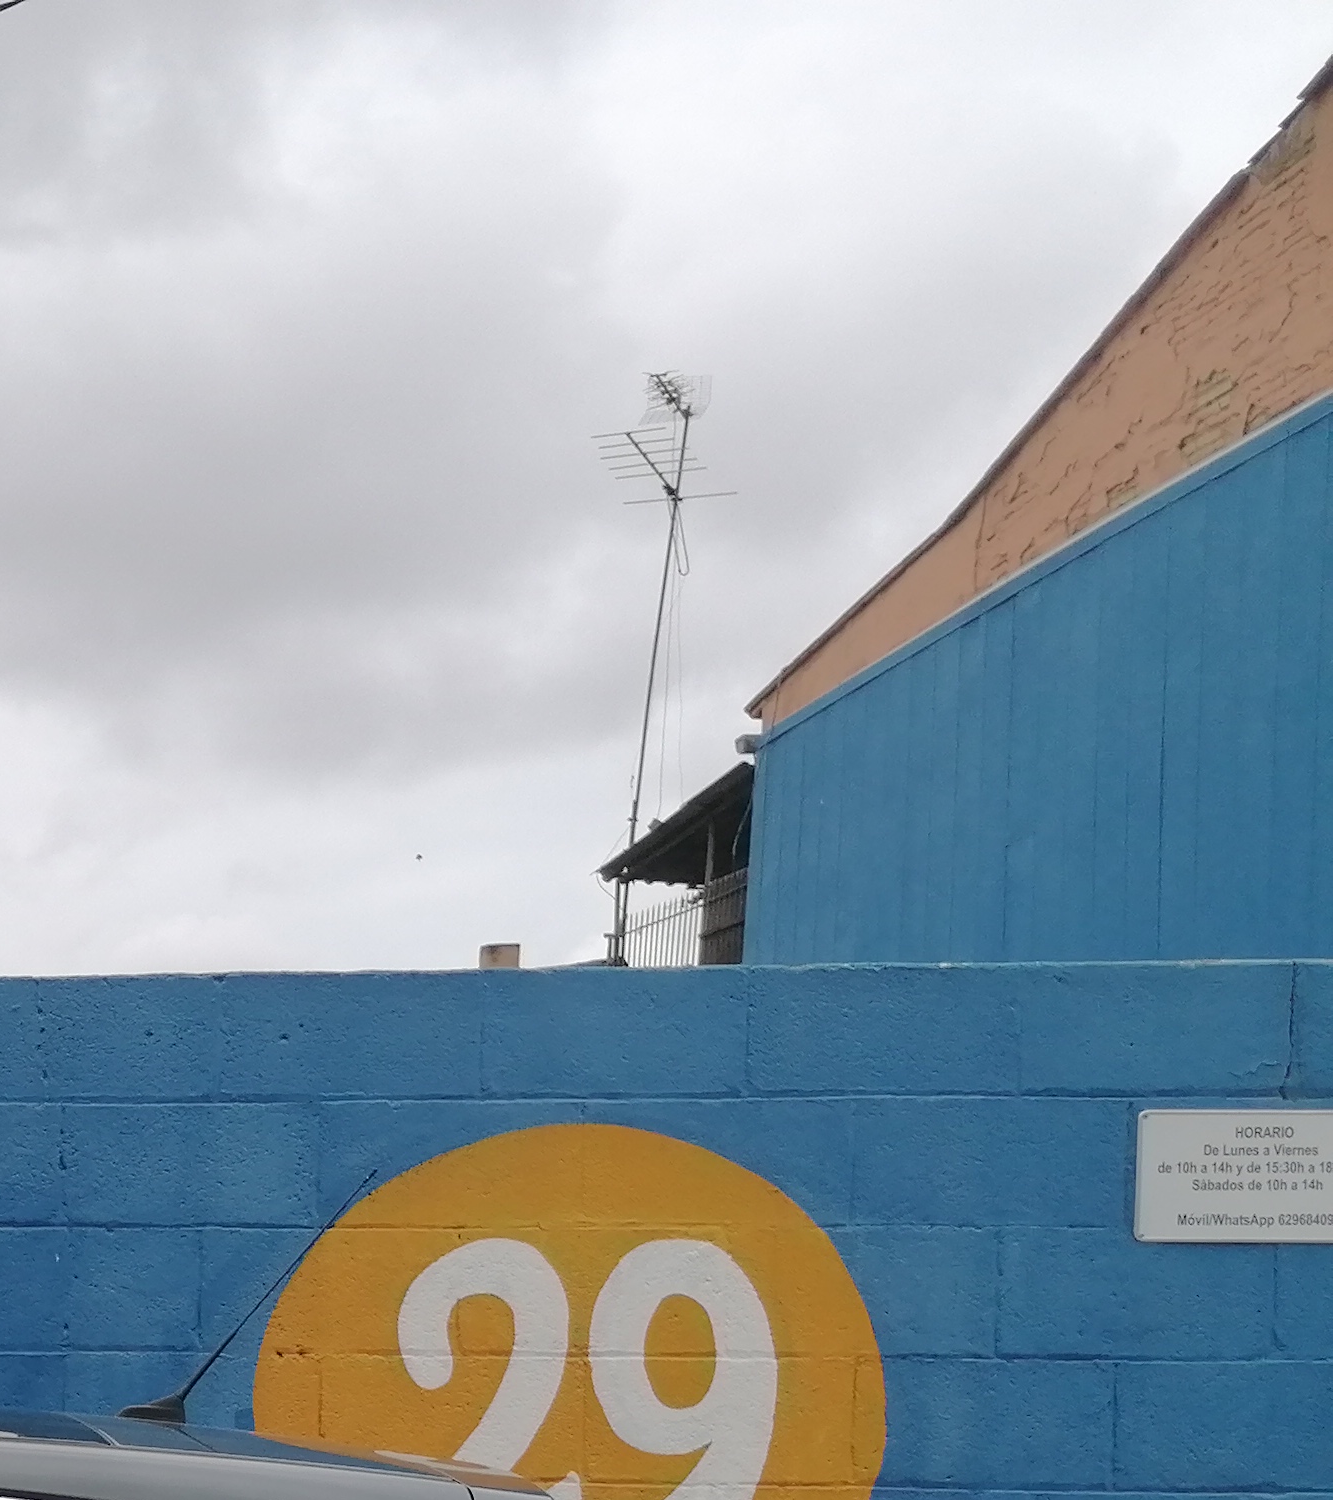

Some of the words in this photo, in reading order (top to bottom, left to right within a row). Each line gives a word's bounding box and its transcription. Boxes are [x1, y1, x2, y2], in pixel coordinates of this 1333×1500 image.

[1235, 1126, 1295, 1139] HORARIO
[1203, 1144, 1219, 1156] De
[1223, 1144, 1260, 1156] Lunes
[1262, 1147, 1270, 1156] a
[1274, 1143, 1319, 1156] Viernes
[1157, 1161, 1172, 1174] de
[1177, 1161, 1197, 1174] 10h
[1200, 1164, 1208, 1174] a
[1212, 1161, 1233, 1174] 14h
[1236, 1165, 1243, 1177] y
[1246, 1161, 1261, 1174] de
[1266, 1161, 1304, 1174] 15:30h
[1308, 1164, 1315, 1174] a
[1248, 1179, 1263, 1191] de
[1267, 1179, 1288, 1191] 10h
[1291, 1182, 1298, 1191] a
[1303, 1179, 1324, 1191] 14h
